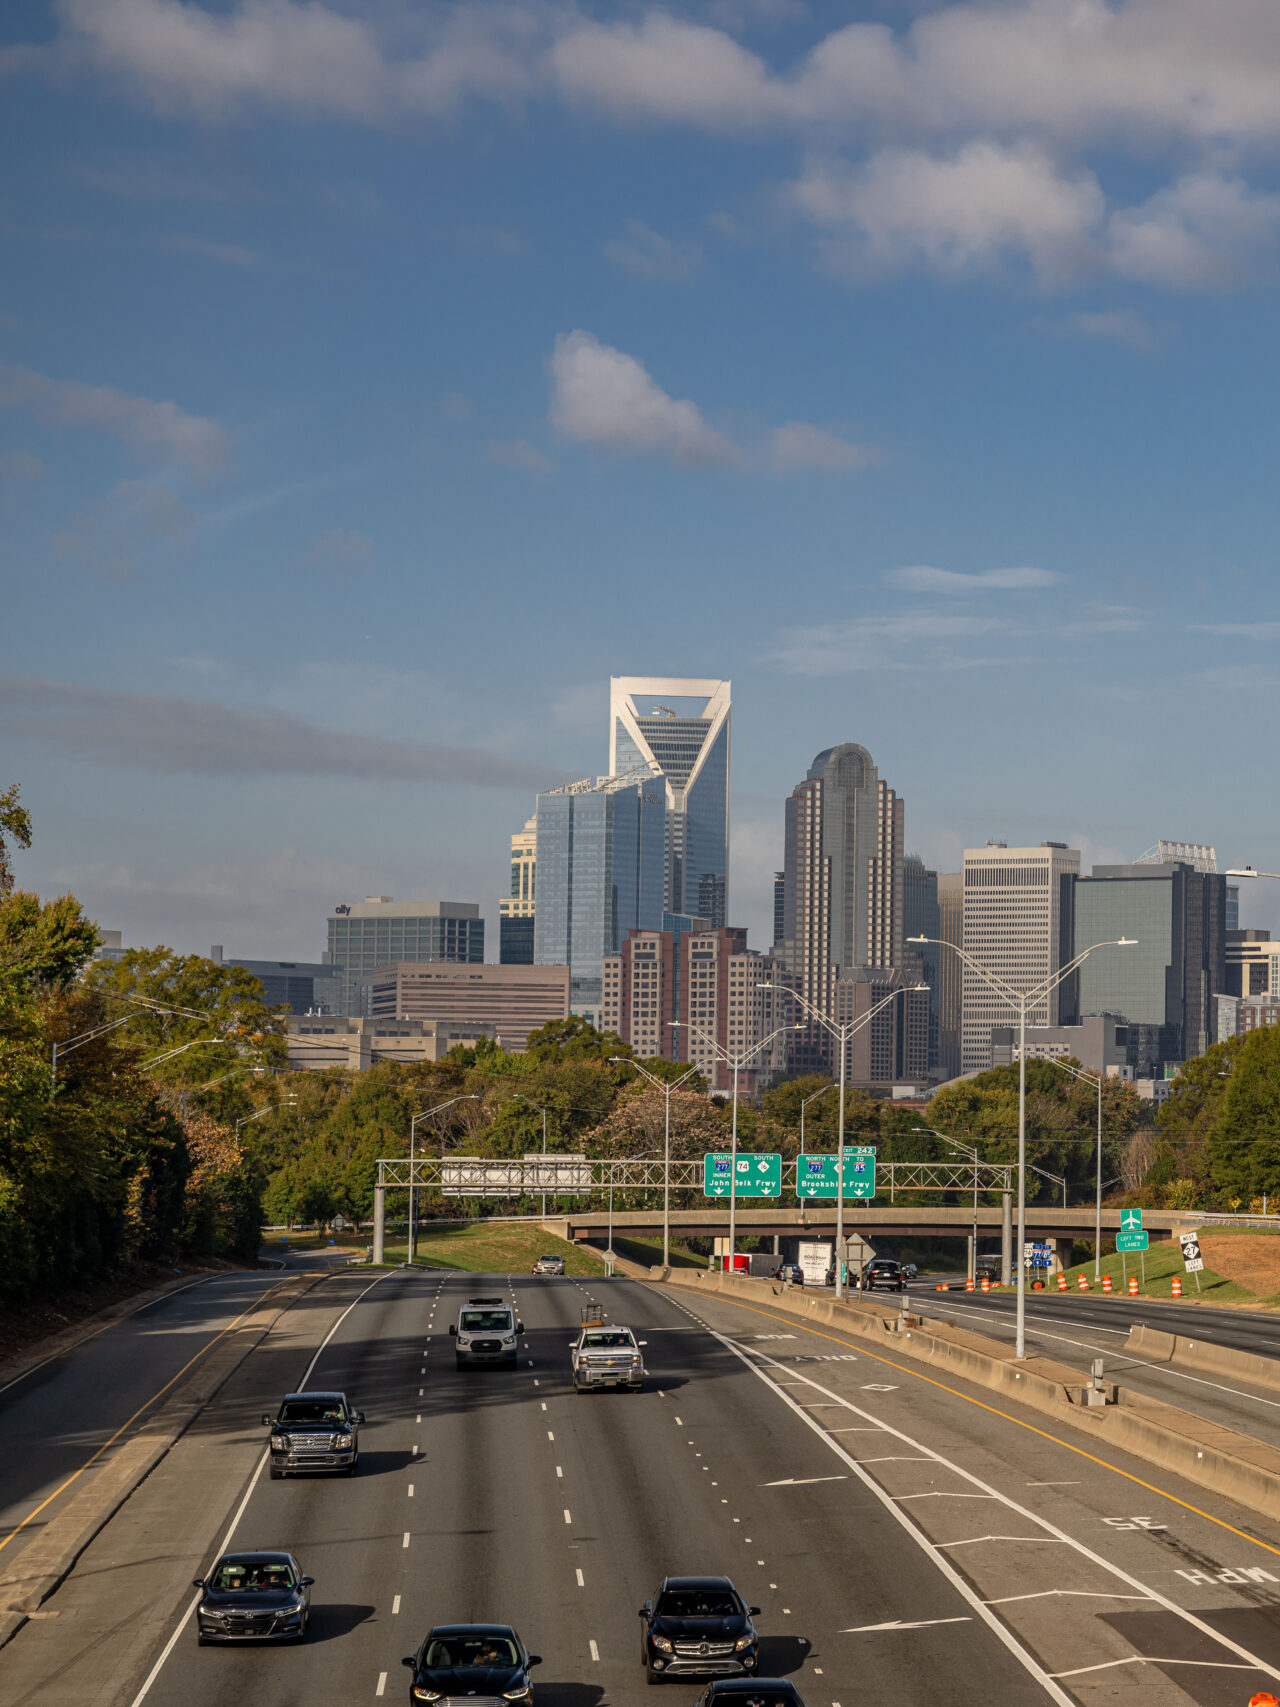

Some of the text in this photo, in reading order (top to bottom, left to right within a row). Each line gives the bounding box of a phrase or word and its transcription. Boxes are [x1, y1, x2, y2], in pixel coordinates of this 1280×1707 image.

[335, 904, 351, 916] ally
[849, 1181, 870, 1189] Frwy
[1185, 1246, 1196, 1256] 27
[1174, 1566, 1280, 1586] MPH
